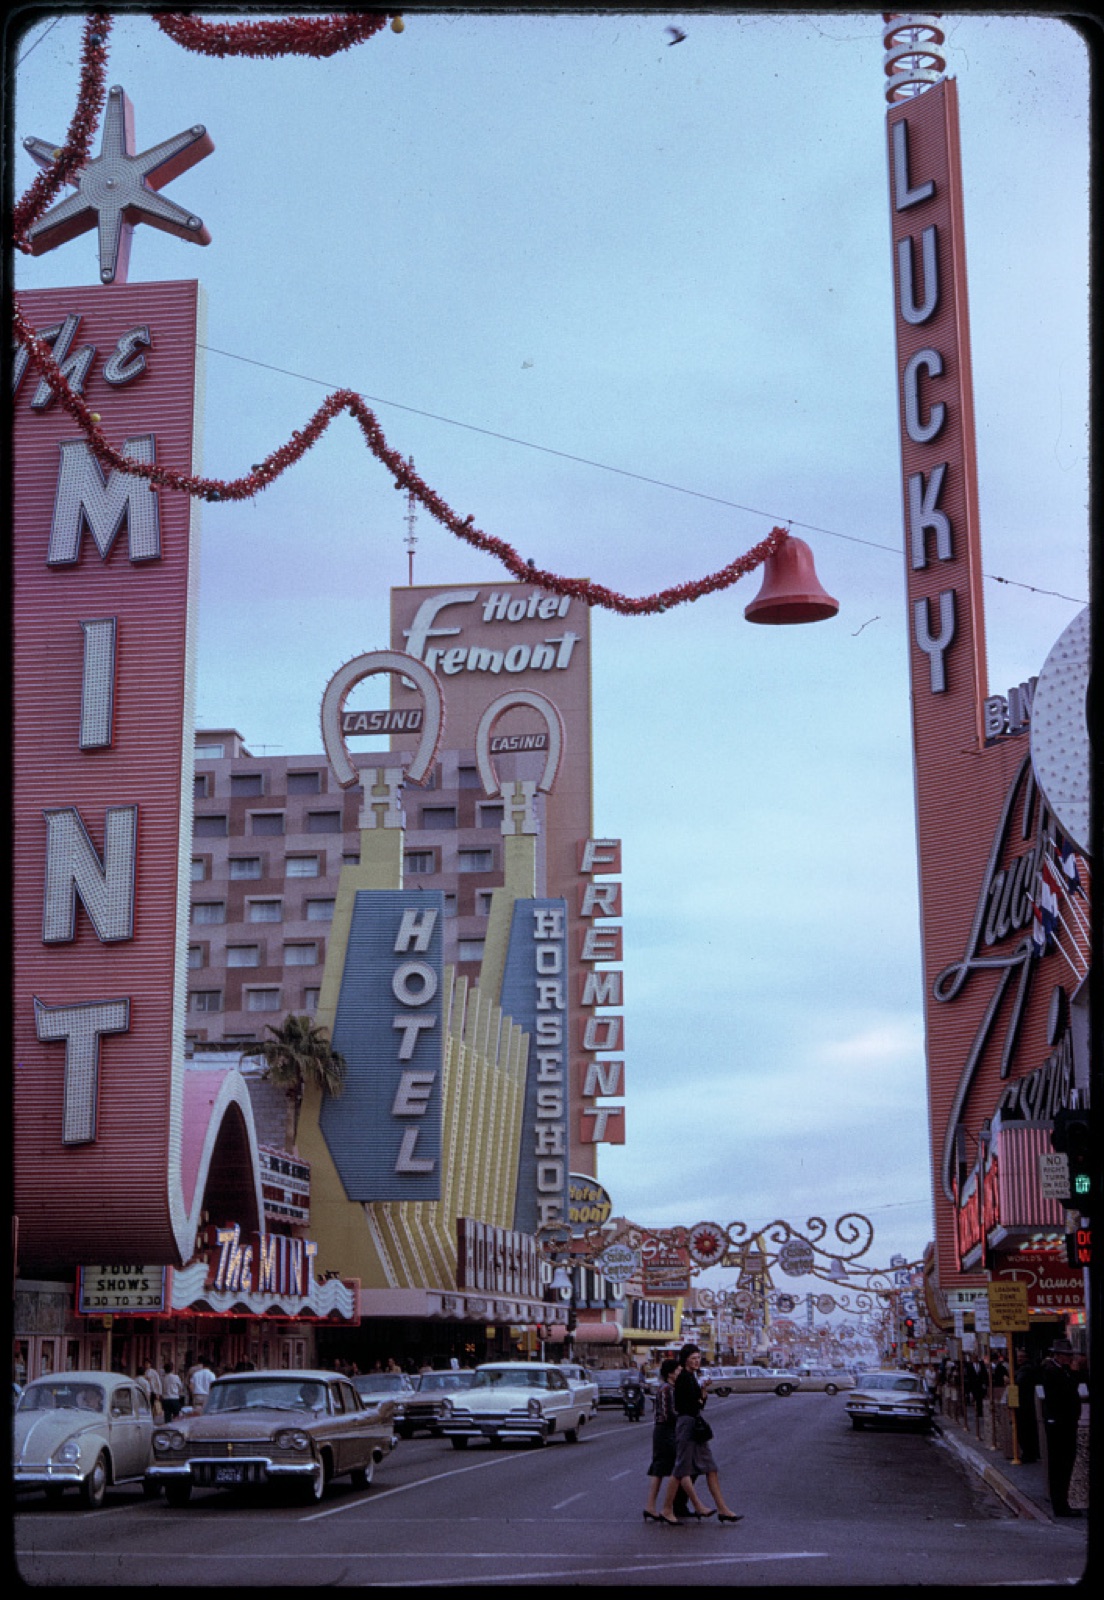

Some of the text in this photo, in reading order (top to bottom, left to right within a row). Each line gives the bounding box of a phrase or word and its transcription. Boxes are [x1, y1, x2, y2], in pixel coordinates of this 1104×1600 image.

[890, 116, 960, 696] LUCKY
[482, 591, 571, 622] Hotel
[402, 590, 581, 690] Fremont
[343, 709, 422, 732] CASINO
[491, 734, 547, 752] CASINO
[34, 433, 162, 1145] MINT
[358, 768, 405, 829] H
[500, 781, 539, 835] H
[581, 840, 622, 1142] FREMONT
[392, 907, 439, 1173] HOTEL
[533, 907, 566, 1228] HORSESHOE
[1046, 1156, 1061, 1164] NO
[97, 1279, 149, 1291] SHOWS
[101, 1265, 144, 1275] FOUR
[215, 1223, 318, 1297] The MINT
[115, 1296, 129, 1306] TO
